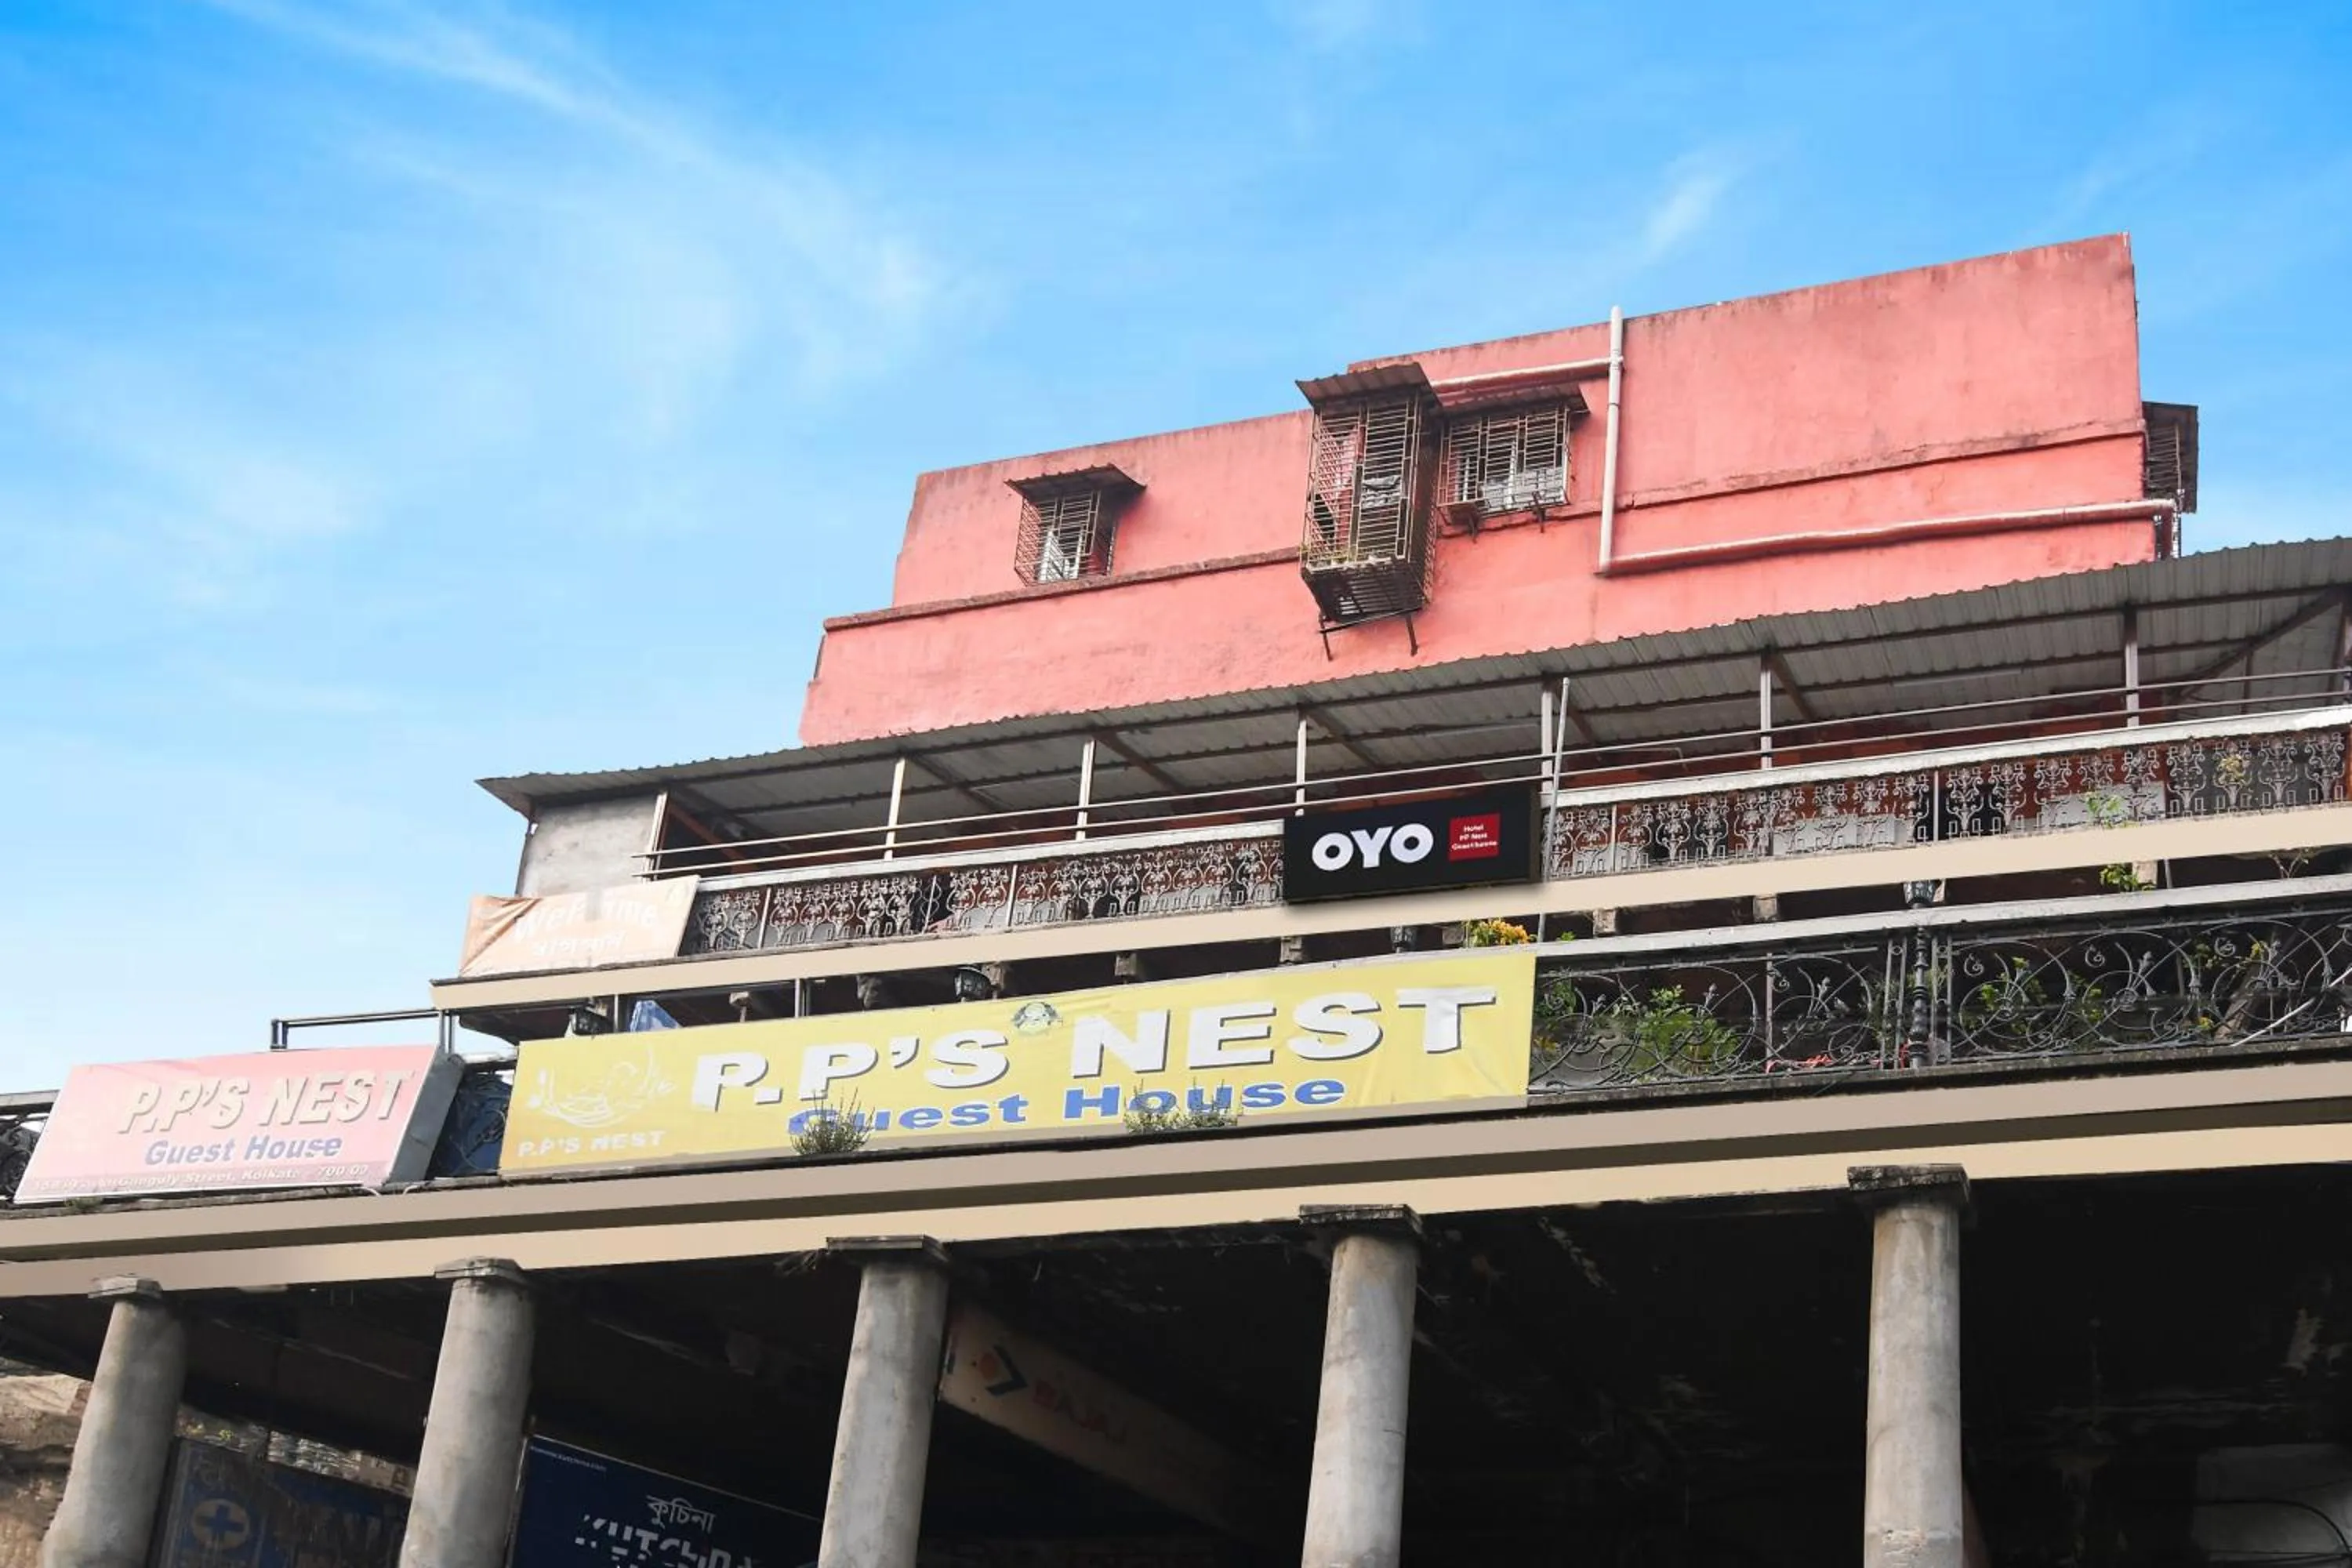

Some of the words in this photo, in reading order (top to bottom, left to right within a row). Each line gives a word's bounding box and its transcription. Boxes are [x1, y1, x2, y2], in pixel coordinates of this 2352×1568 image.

[1312, 822, 1434, 872] OYO
[1073, 985, 1497, 1079] NEST
[259, 1069, 416, 1127] NEST
[1062, 1078, 1346, 1120] House
[145, 1138, 234, 1165] Guest
[244, 1134, 343, 1160] House
[590, 1130, 665, 1151] NEST
[645, 1494, 717, 1534] কুচিনা
